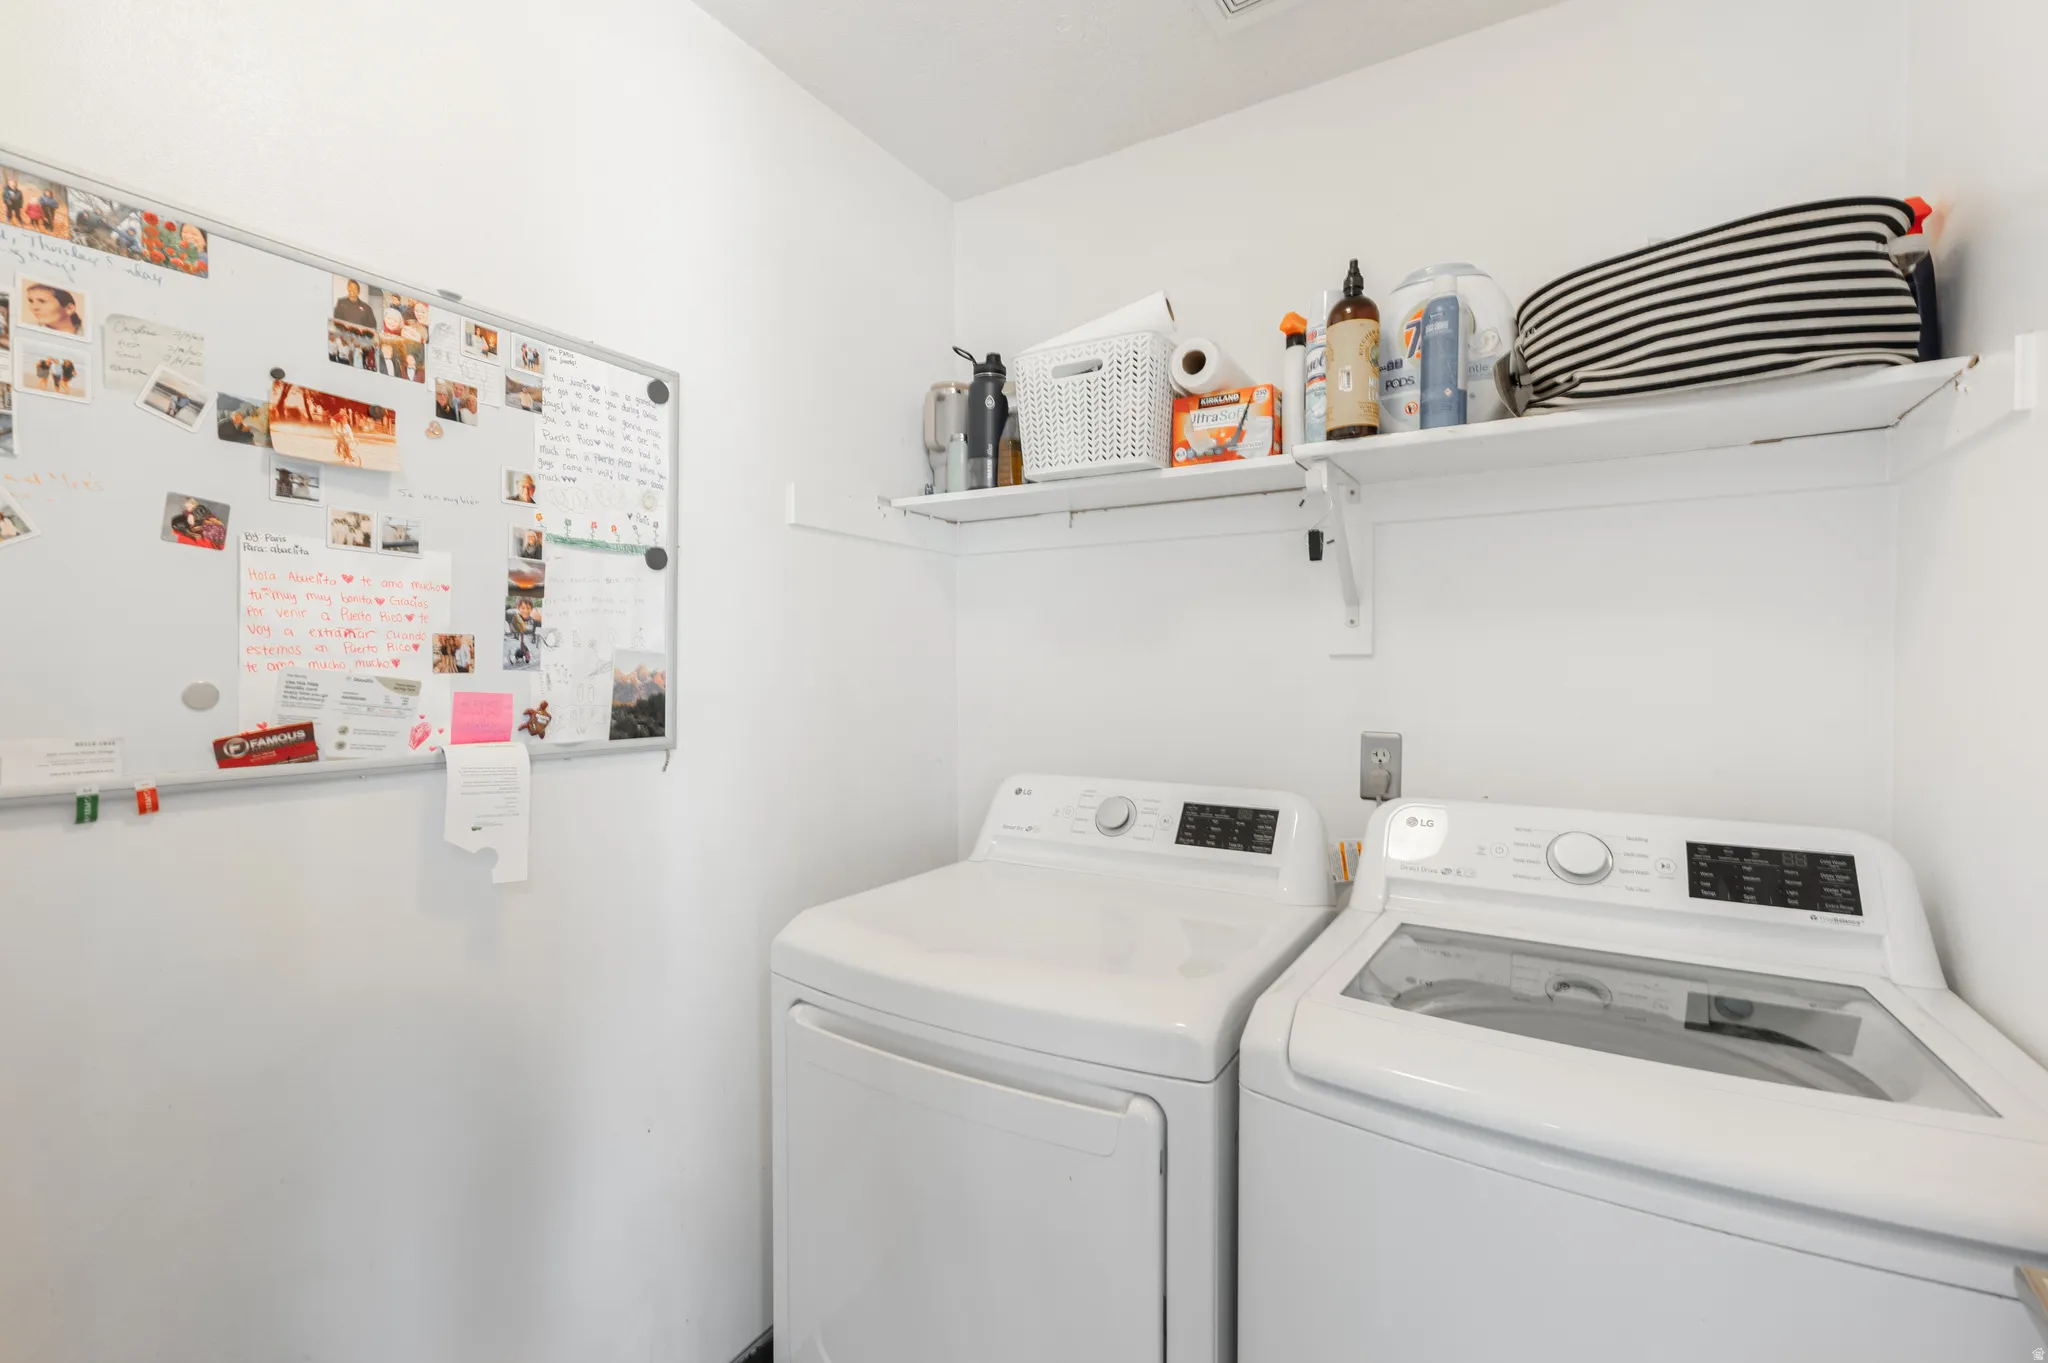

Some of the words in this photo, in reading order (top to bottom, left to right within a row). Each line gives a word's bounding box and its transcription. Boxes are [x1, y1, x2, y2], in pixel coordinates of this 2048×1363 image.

[1468, 364, 1490, 373] ntle
[1385, 375, 1415, 391] PODS
[1200, 392, 1240, 406] KIRKLAND
[541, 428, 571, 443] Puerto
[244, 532, 263, 542] By:
[265, 534, 287, 543] Paris
[270, 544, 310, 556] abuelita
[248, 568, 276, 581] Hola
[288, 571, 338, 587] Abuelita
[360, 575, 373, 588] te
[381, 579, 404, 589] amo
[411, 581, 441, 593] mucho
[271, 591, 298, 605] muy
[306, 591, 333, 606] muy
[340, 592, 373, 606] bonita
[389, 595, 429, 609] Gracias
[321, 611, 331, 622] a
[340, 608, 372, 623] Puerto
[380, 610, 403, 623] Rico
[419, 613, 429, 624] te
[284, 626, 294, 637] a
[246, 643, 302, 656] estemos
[314, 643, 329, 653] en
[343, 642, 379, 655] Puerto
[386, 642, 411, 653] Rico
[244, 661, 258, 673] te
[308, 659, 346, 671] mucho
[355, 657, 390, 669] mucho
[250, 729, 306, 749] FAMOUS
[1023, 788, 1033, 796] LG
[1420, 818, 1434, 828] LG
